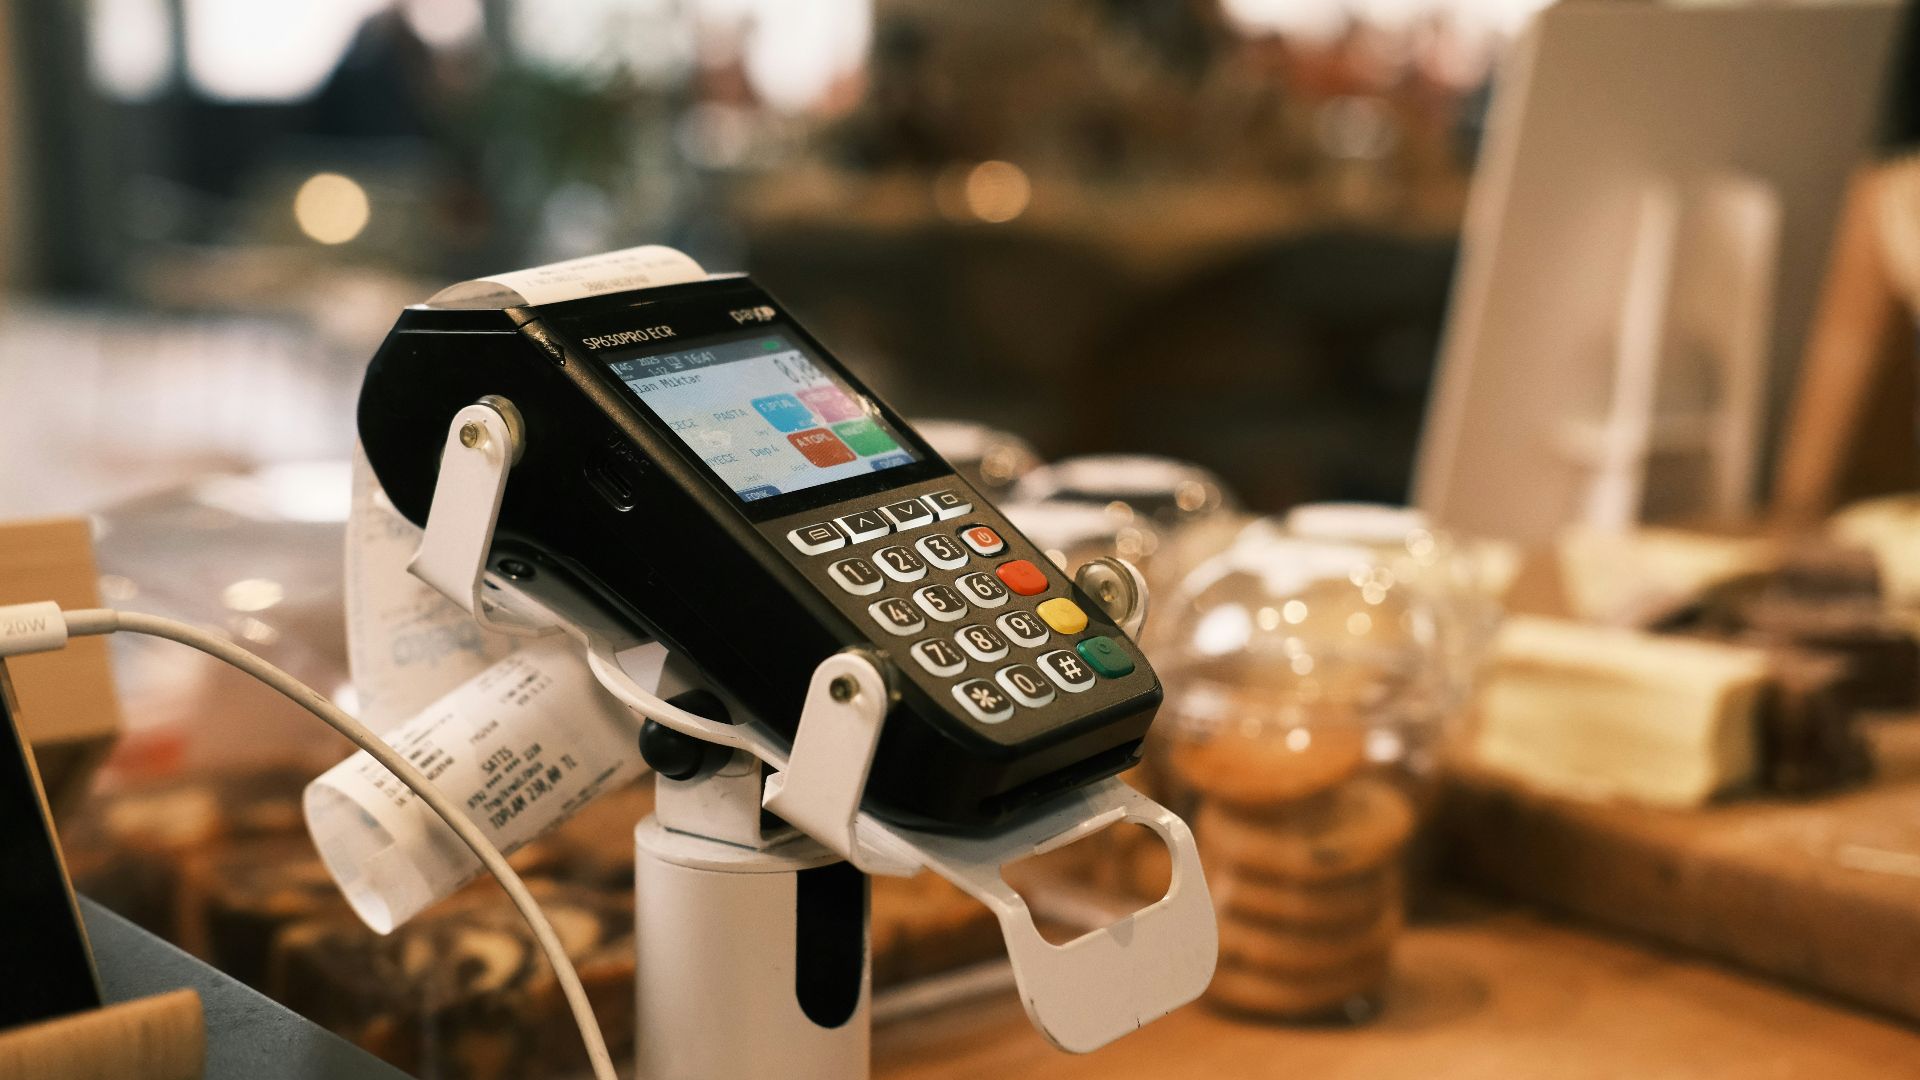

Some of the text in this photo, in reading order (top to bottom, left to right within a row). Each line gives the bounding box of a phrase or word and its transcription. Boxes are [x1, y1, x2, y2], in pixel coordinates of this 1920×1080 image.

[582, 325, 677, 350] SP630PRO ECR
[659, 374, 702, 389] Miktar
[713, 409, 749, 422] PASTA
[928, 536, 961, 558] 3 DEF
[887, 548, 921, 571] 2 ABC
[843, 563, 865, 583] 1
[972, 577, 993, 597] 6
[925, 591, 947, 611] 5
[887, 604, 909, 623] 4
[3, 616, 47, 636] 20W
[1010, 617, 1031, 636] 9
[970, 630, 993, 650] 8
[925, 643, 947, 665] 7
[1013, 673, 1037, 694] 0
[560, 753, 577, 771] TL
